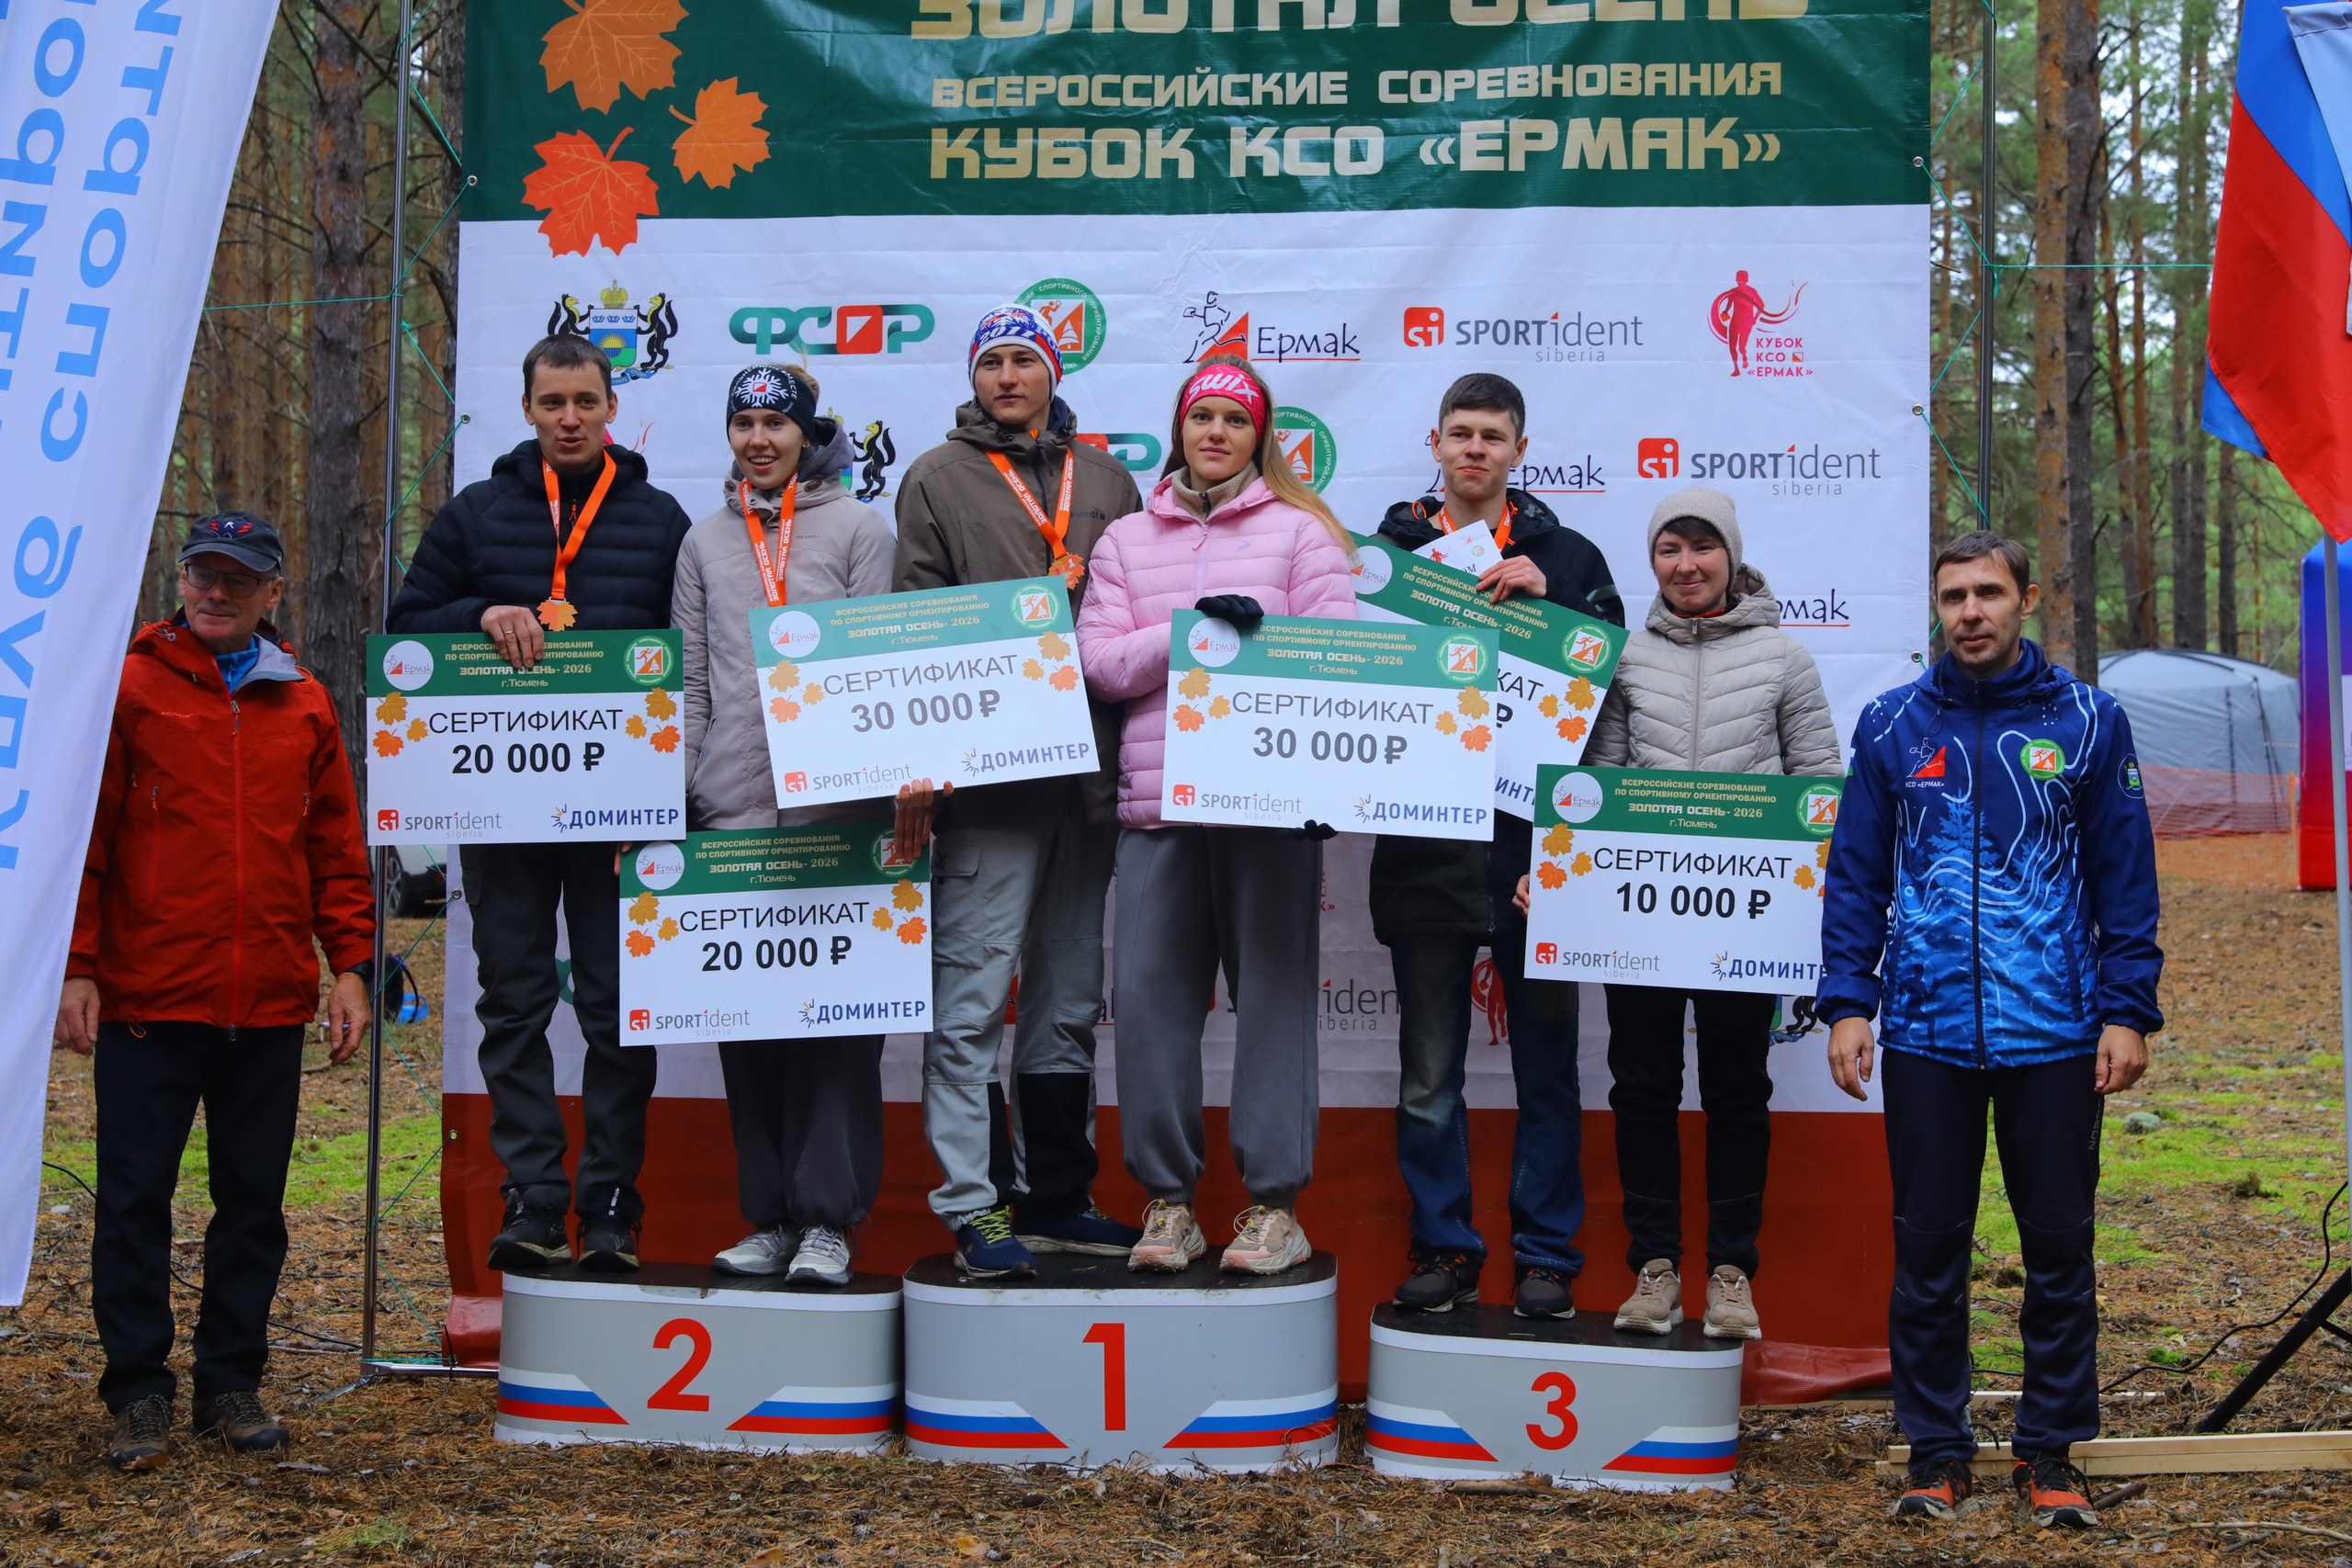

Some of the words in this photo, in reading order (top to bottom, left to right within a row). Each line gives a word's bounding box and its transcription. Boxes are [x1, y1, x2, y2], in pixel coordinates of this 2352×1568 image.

[931, 66, 1348, 107] ВСЕРОССИЙСКИЕ
[1378, 62, 1781, 104] СОРЕВНОВАНИЯ
[930, 126, 1194, 179] КУБОК
[1229, 125, 1384, 177] КСО
[1419, 118, 1781, 172] «ЕРМАК»
[1456, 311, 1643, 346] SPORTident
[1257, 323, 1360, 363] Ермак
[1756, 337, 1803, 348] КУБОК
[1536, 347, 1604, 363] siberia
[1756, 352, 1786, 363] КСО
[1747, 367, 1813, 377] «ЕРМАК»
[1274, 412, 1317, 427] ОРТИВНОГО
[1690, 444, 1881, 479] SPORTident
[1772, 480, 1842, 495] siberia
[1403, 572, 1414, 581] ПО
[1416, 576, 1473, 601] СПОРТИВНОМУ
[835, 602, 908, 616] ВСЕРОССИЙСКИЕ
[910, 594, 978, 608] СОРЕВНОВАНИЯ
[1479, 590, 1543, 616] СОНОВАНИЯ
[1775, 589, 1849, 623] мак
[831, 618, 842, 626] ПО
[844, 612, 907, 625] СПОРТИВНОМУ
[909, 602, 989, 616] ОРИЕНТИРОВАНИЮ
[1410, 590, 1460, 614] ЗОЛОТАЯ
[1504, 623, 1532, 639] 2026
[791, 631, 820, 642] Ермак
[847, 625, 902, 638] ЗОЛОТАЯ
[952, 615, 980, 626] 2026
[1260, 625, 1334, 636] ВСЕРОССИЙСКИЕ
[1336, 629, 1407, 641] СОРЕВНОВАНИЯ
[891, 634, 938, 645] г.Тюмень
[1210, 641, 1238, 651] Ермак
[1267, 635, 1331, 646] СПОРТИВНОМУ
[1333, 639, 1417, 651] ОРИЕНТИРОВАНИЮ
[458, 652, 503, 660] СПОРТИВН
[542, 650, 605, 659] ЕНТИРОВАНИЮ
[1267, 649, 1322, 660] ЗОЛОТАЯ
[1374, 655, 1404, 665] 2026
[404, 663, 432, 674] Ермак
[460, 666, 514, 675] ЗОЛОТАЯ
[563, 664, 592, 673] 2026
[824, 655, 1018, 694] СЕРТИФИКАТ
[1309, 664, 1358, 675] г.Тюмень
[502, 678, 548, 687] г.Тюмень
[851, 701, 894, 733] 30
[1232, 692, 1434, 725] СЕРТИФИКАТ
[429, 709, 623, 733] СЕРТИФИКАТ
[1253, 727, 1296, 758] 30
[452, 744, 493, 773] 20
[507, 742, 571, 773] 000
[582, 742, 605, 771] ₽
[981, 742, 1090, 773] ДОМИНТЕР
[813, 763, 912, 790] SPORTident
[1622, 778, 1694, 789] ВСЕРОССИЙСКИЕ
[1697, 782, 1766, 793] СОРЕВНОВАНИЯ
[857, 783, 894, 794] siberia
[1628, 789, 1691, 799] СПОРТИВНОМУ
[1693, 792, 1777, 803] ОРИЕНТИРОВАНИЮ
[1201, 793, 1302, 814] SPORTident
[1573, 795, 1600, 807] Ермак
[1628, 803, 1682, 814] ЗОЛОТАЯ
[1733, 807, 1763, 818] 2026
[404, 811, 502, 830] SPORTident
[570, 808, 679, 829] ДОМИНТЕР
[1244, 812, 1282, 821] siberia
[1373, 802, 1487, 825] ДОМИНТЕР
[1669, 818, 1717, 829] г.Тюмень
[447, 829, 482, 838] siberia
[702, 838, 772, 849] ВСЕРОССИЙСКИЕ
[774, 835, 840, 844] СОРЕВНОВАНИЯ
[708, 848, 770, 858] СПОРТИВНОМУ
[772, 844, 851, 854] ОРИЕНТИРОВАНИЮ
[656, 863, 684, 874] Ермак
[709, 863, 762, 874] ЗОЛОТАЯ
[810, 857, 839, 867] 2026
[1594, 847, 1792, 879] СЕРТИФИКАТ
[750, 874, 796, 884] г.Тюмень
[1616, 882, 1657, 914] 10
[1670, 886, 1736, 918] 000
[1747, 889, 1771, 919] ₽
[680, 902, 870, 931] СЕРТИФИКАТ
[702, 941, 742, 972] 20
[756, 937, 818, 969] 000
[831, 936, 852, 964] ₽
[1562, 950, 1660, 972] SPORTident
[1603, 969, 1640, 979] siberia
[1729, 958, 1828, 980] ДОМИНТЕ
[655, 1009, 750, 1030] SPORTident
[817, 1000, 926, 1024] ДОМИНТЕР
[695, 1028, 731, 1036] siberia
[1319, 1015, 1376, 1031] iberia
[649, 1317, 712, 1411] 2
[1083, 1323, 1126, 1431] 1
[1526, 1371, 1578, 1450] 3
